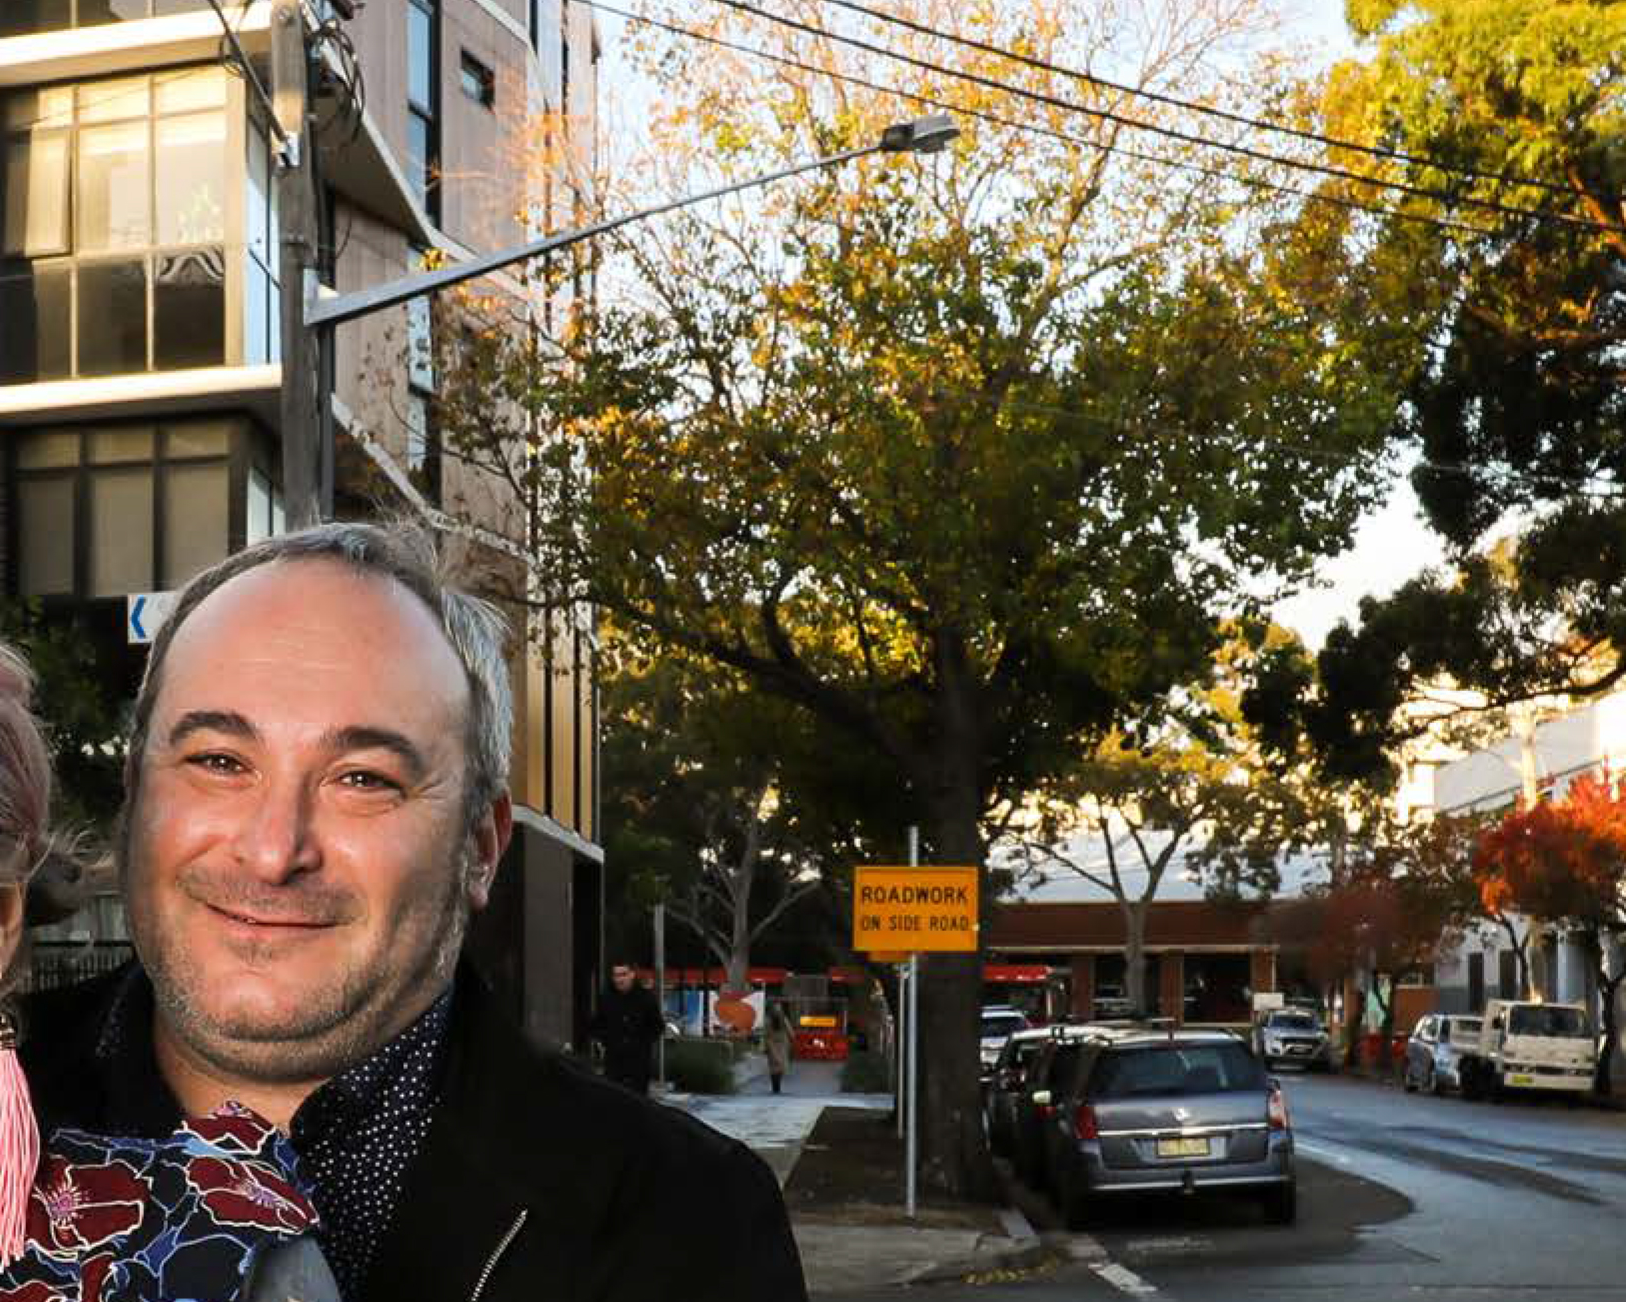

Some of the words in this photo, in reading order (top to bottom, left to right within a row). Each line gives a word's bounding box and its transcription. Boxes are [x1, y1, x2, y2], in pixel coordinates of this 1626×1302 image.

[861, 885, 967, 904] ROADWORK
[861, 915, 881, 932] ON
[888, 915, 920, 932] SIDE
[929, 915, 969, 932] ROAD
